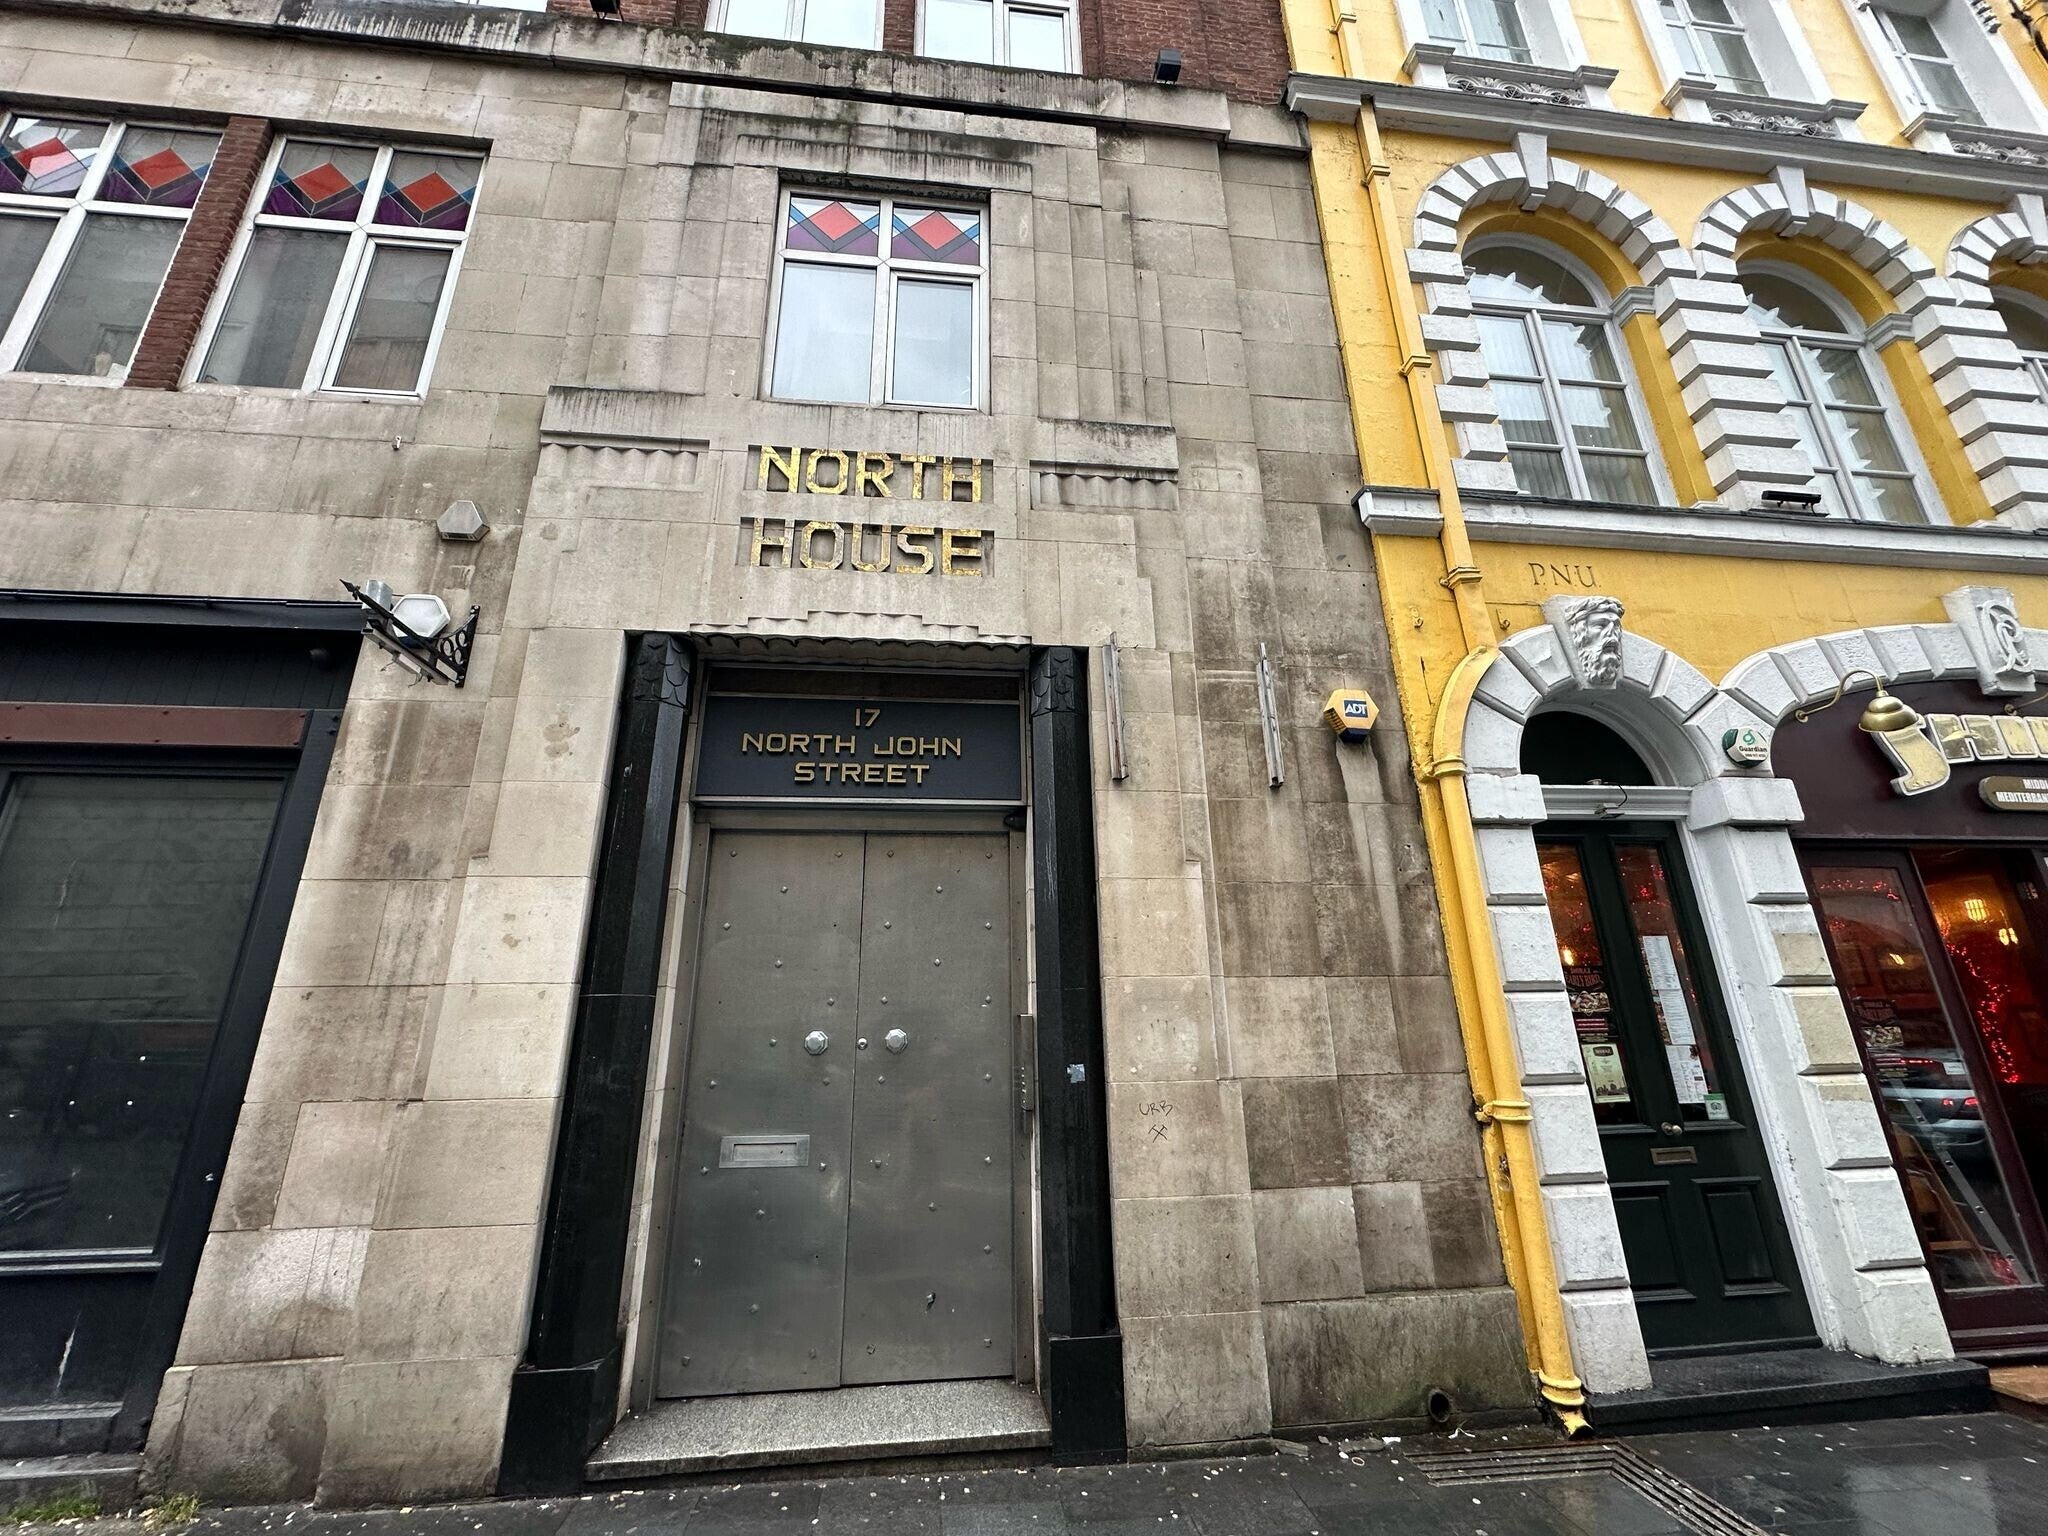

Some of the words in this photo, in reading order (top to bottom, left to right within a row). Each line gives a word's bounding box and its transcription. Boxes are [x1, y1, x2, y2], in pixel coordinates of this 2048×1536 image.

[757, 444, 983, 503] NORTH
[750, 517, 983, 577] HOUSE
[854, 707, 882, 728] 17
[1345, 703, 1368, 715] ADT
[741, 732, 857, 755] NORTH
[873, 735, 963, 757] JOHN
[793, 761, 931, 785] STREET
